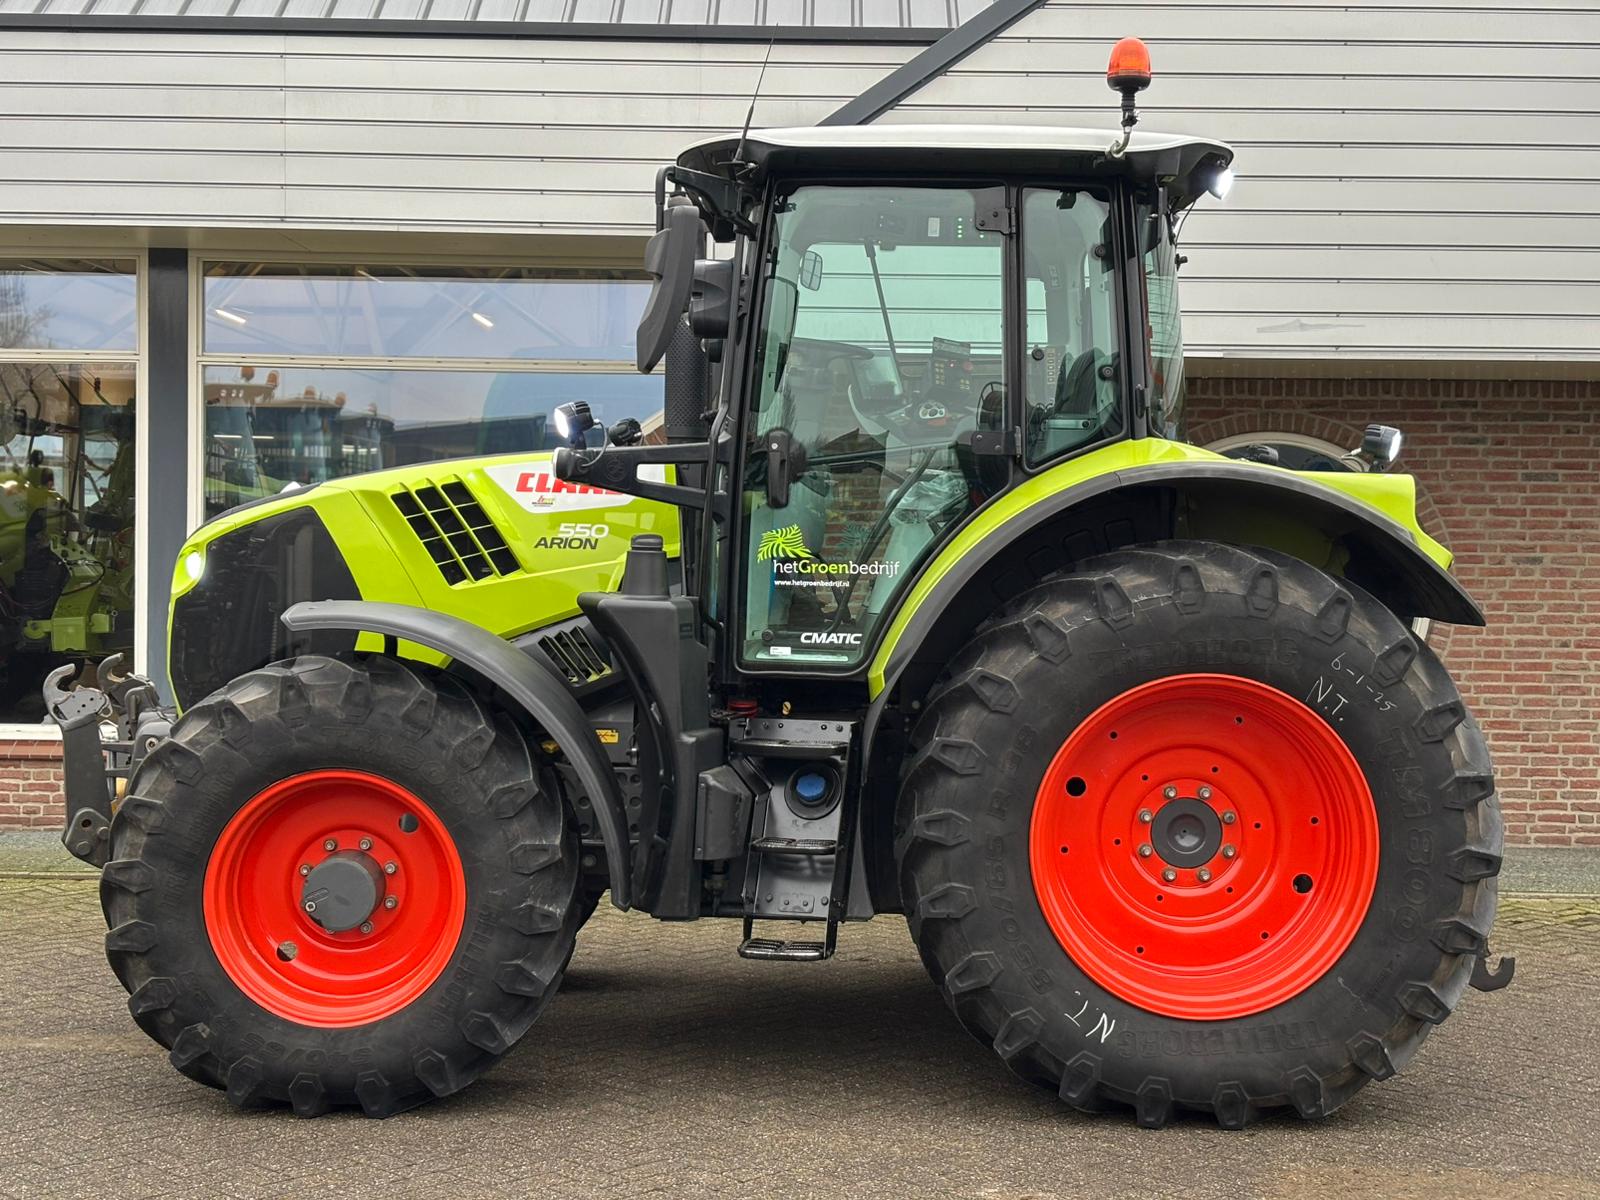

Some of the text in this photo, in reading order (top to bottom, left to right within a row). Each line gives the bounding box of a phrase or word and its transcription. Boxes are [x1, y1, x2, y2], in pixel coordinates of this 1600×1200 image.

[516, 473, 624, 494] CLA
[558, 523, 609, 538] 550
[534, 537, 599, 550] ARION
[773, 560, 900, 578] hetGroenbedrijf
[800, 632, 863, 645] CMATIC
[1331, 651, 1398, 711] 6-1-25
[1305, 675, 1349, 722] N.T.
